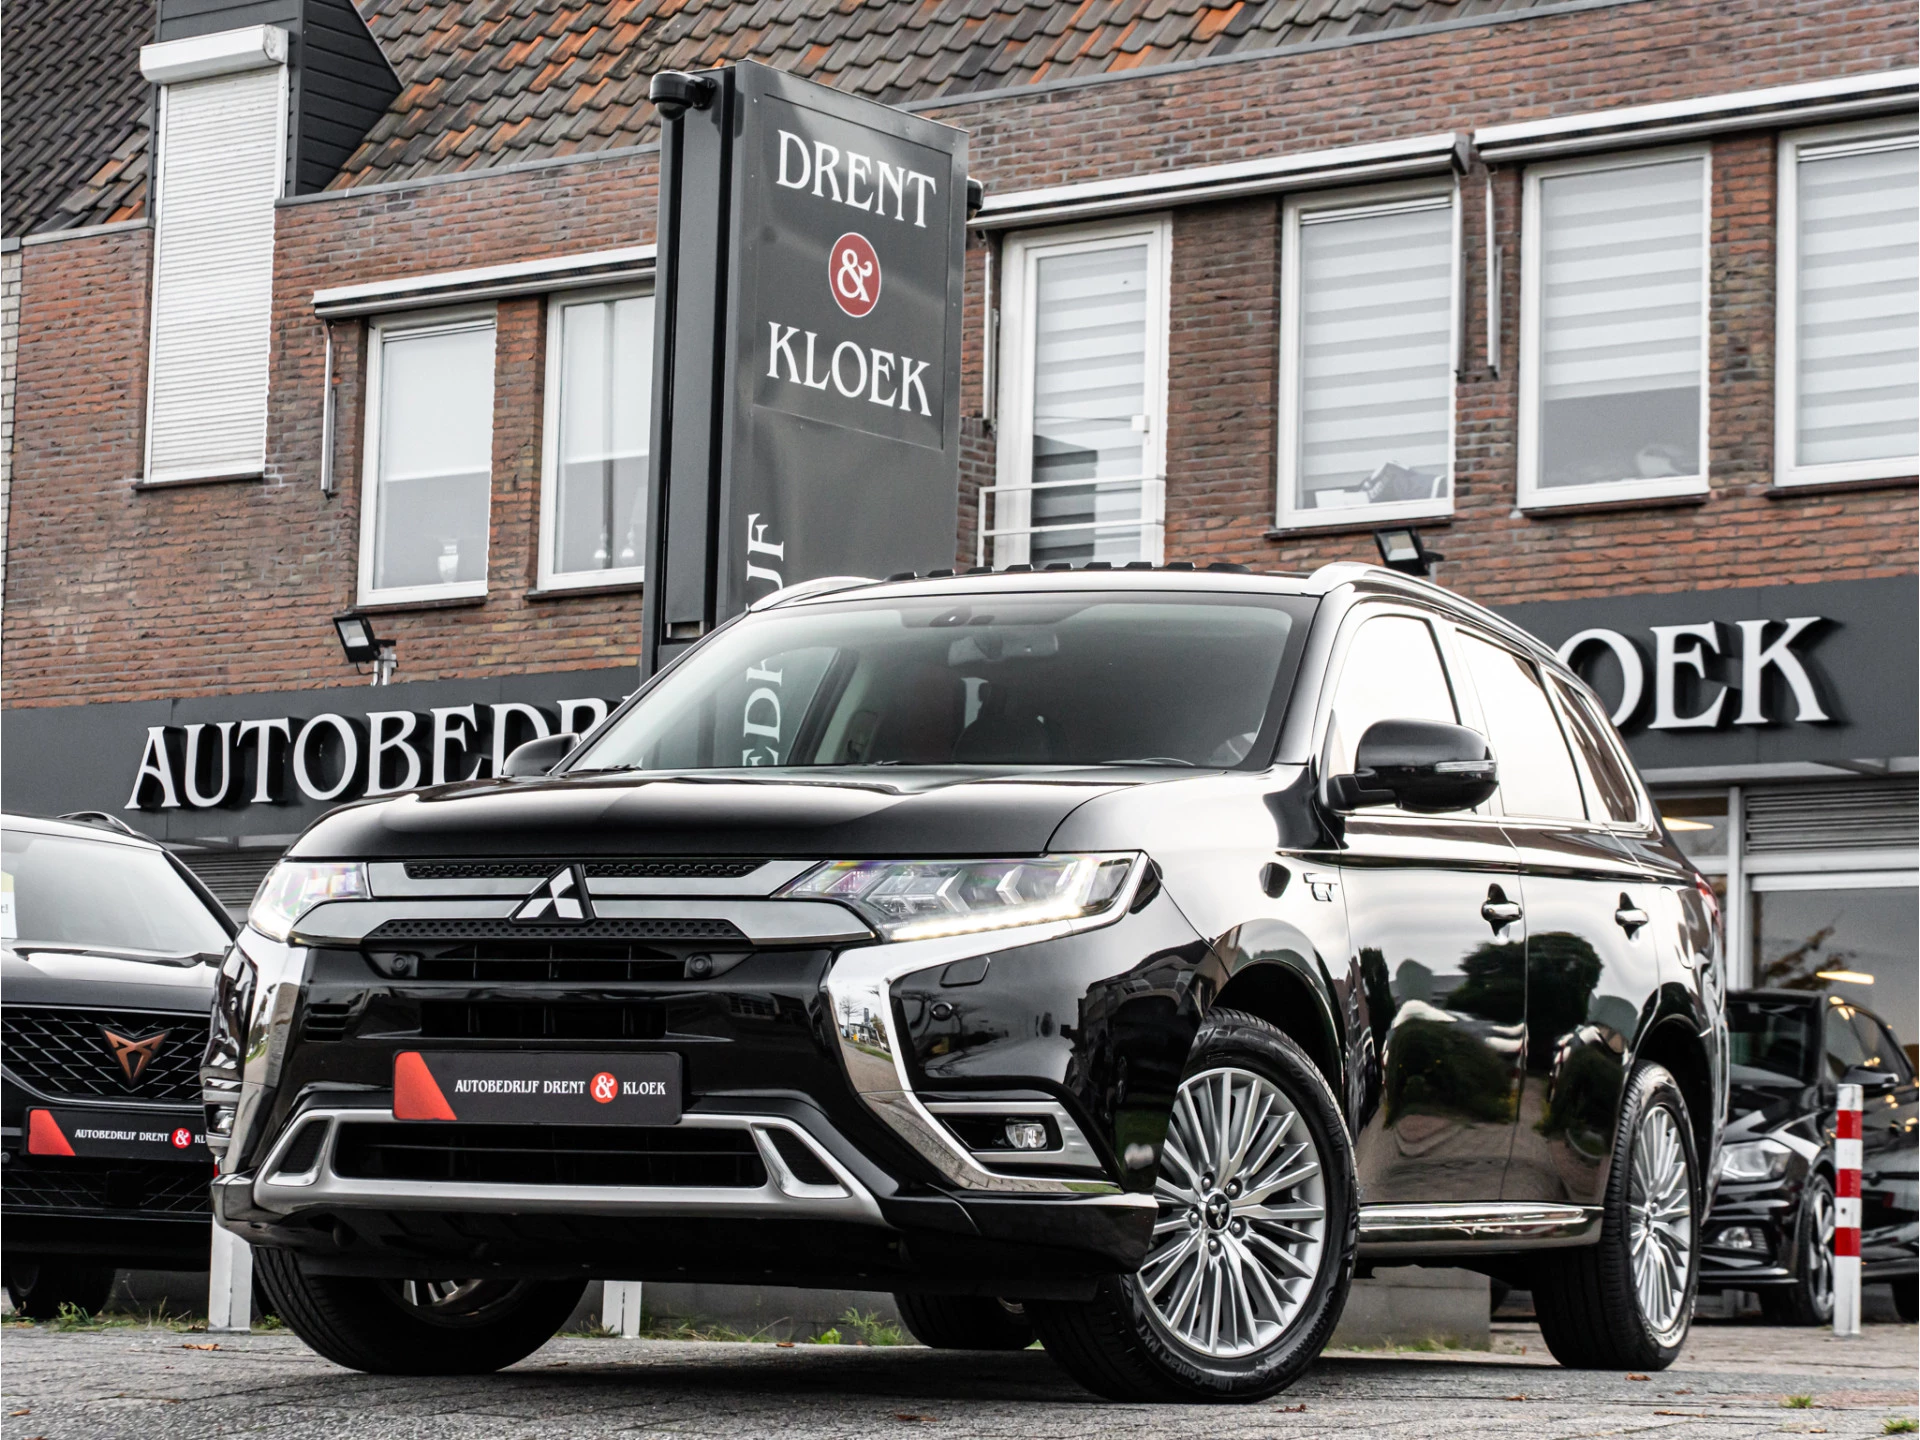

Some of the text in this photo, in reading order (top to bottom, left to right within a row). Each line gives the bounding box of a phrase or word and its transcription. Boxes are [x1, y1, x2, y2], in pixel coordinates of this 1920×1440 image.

[776, 129, 937, 228] DRENT
[836, 248, 873, 303] &
[766, 321, 932, 417] KLOEK
[124, 696, 632, 810] AUTOBEDR
[455, 1075, 666, 1099] AUTOBEDRIJF DRENT & KLOEK
[74, 1128, 136, 1141] AUTOBEDRIJF
[138, 1131, 169, 1143] DRENT
[174, 1130, 189, 1146] &
